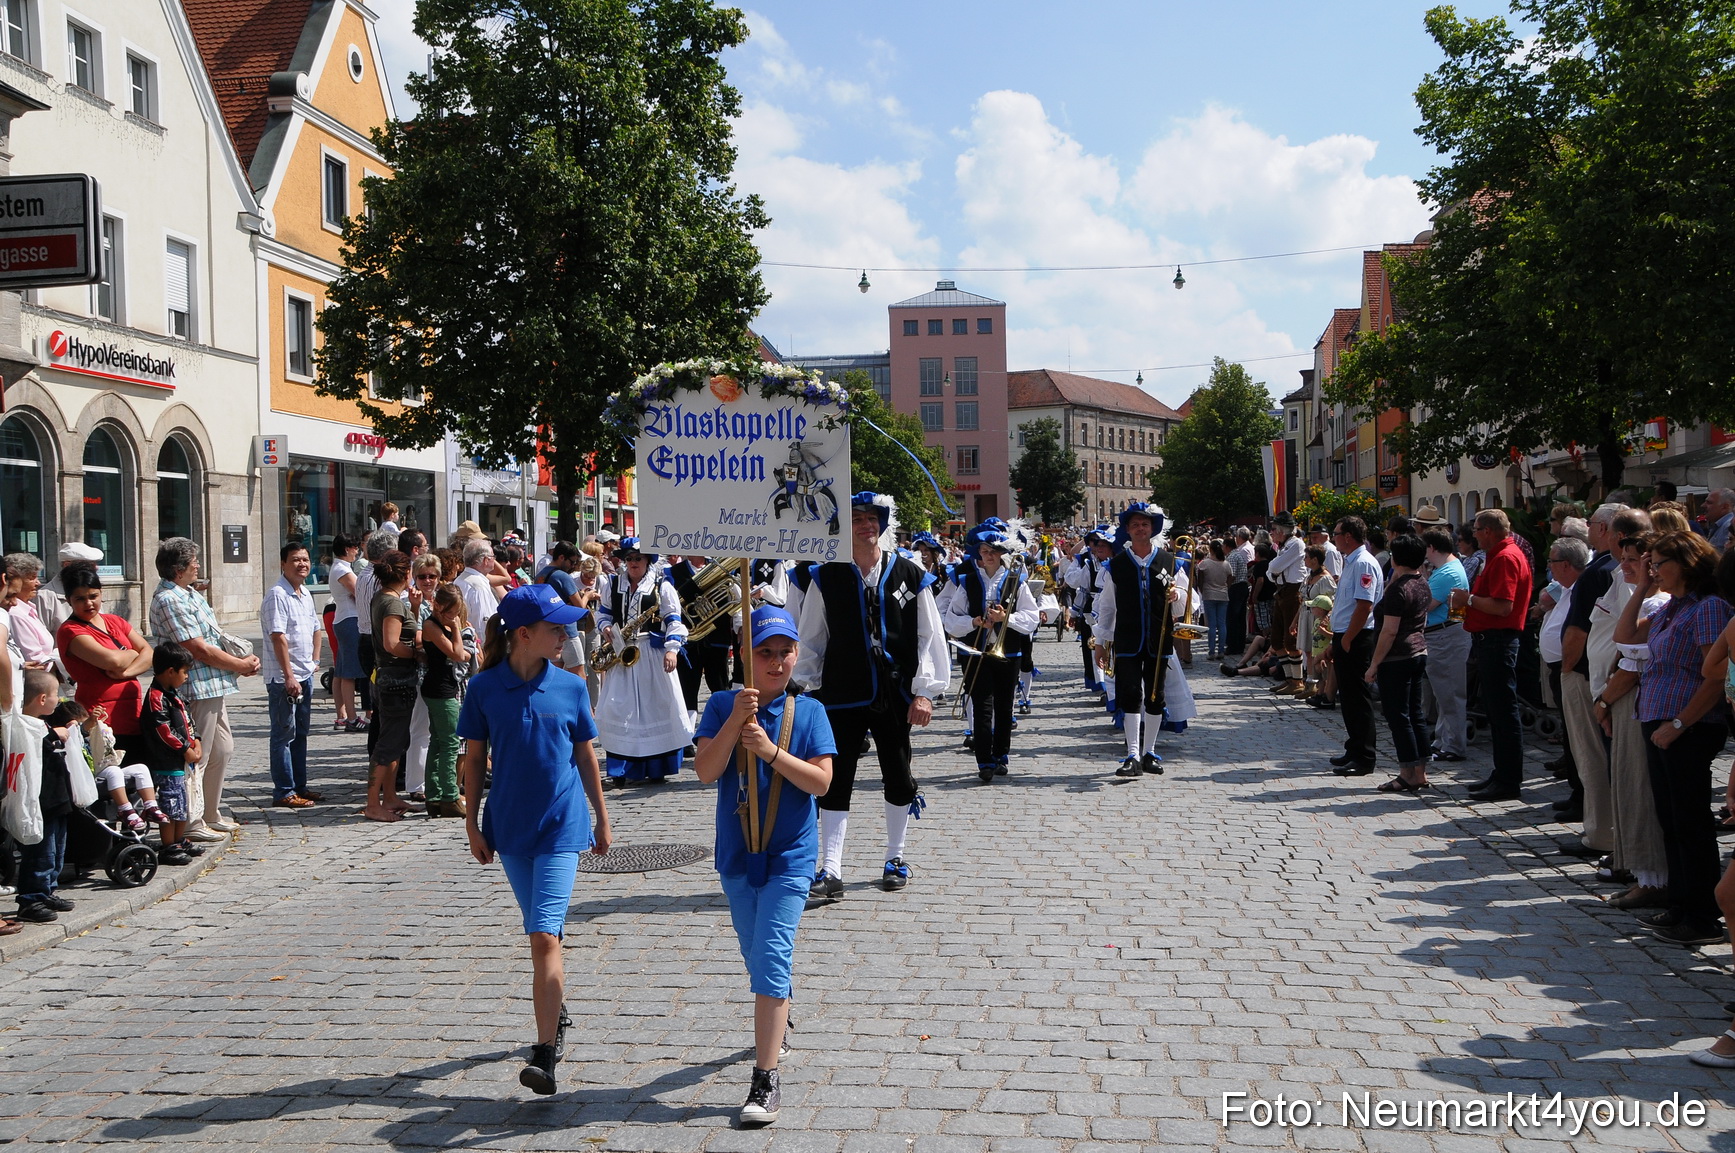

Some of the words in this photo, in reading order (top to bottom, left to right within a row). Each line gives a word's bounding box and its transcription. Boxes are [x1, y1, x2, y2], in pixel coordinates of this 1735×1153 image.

[0, 246, 48, 270] gasse
[69, 336, 176, 378] HypoVereinsbank
[643, 403, 807, 445] Blaskapelle
[647, 445, 765, 487] Eppelein
[718, 508, 768, 526] Markt
[651, 525, 840, 561] Postbauer-Heng
